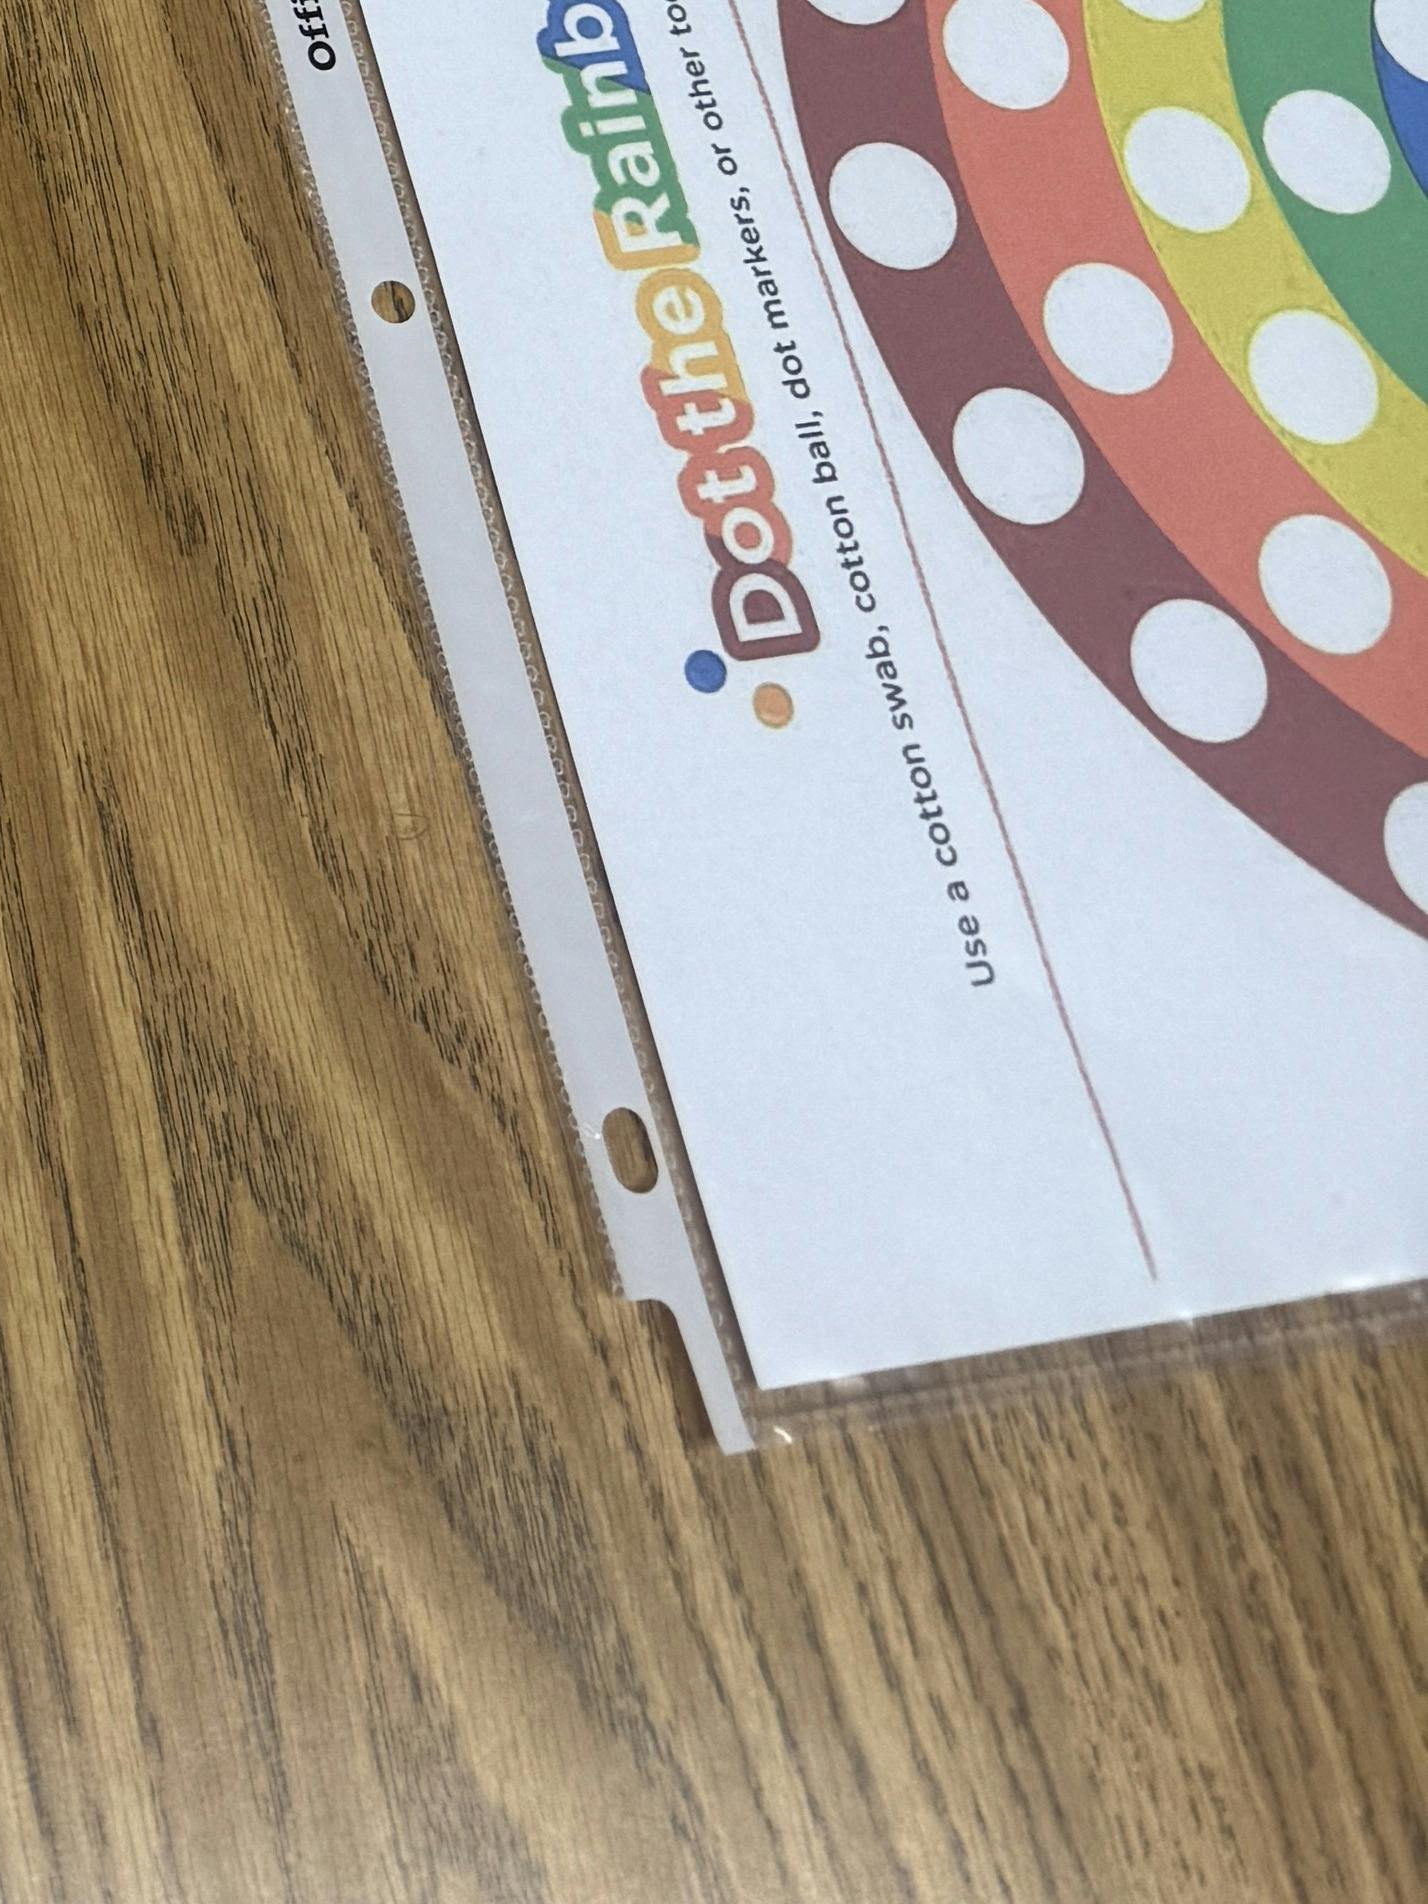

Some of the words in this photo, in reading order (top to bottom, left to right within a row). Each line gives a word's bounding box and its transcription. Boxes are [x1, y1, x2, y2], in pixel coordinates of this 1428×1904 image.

[679, 47, 723, 131] other
[711, 143, 738, 176] or
[730, 187, 789, 330] markers,
[652, 284, 737, 435] the
[773, 340, 811, 399] dot
[795, 411, 838, 484] ball,
[696, 464, 804, 642] Dot
[826, 495, 876, 613] cotton
[865, 625, 913, 730] swab,
[902, 744, 957, 867] cotton
[947, 880, 970, 901] a
[958, 915, 995, 987] Use
